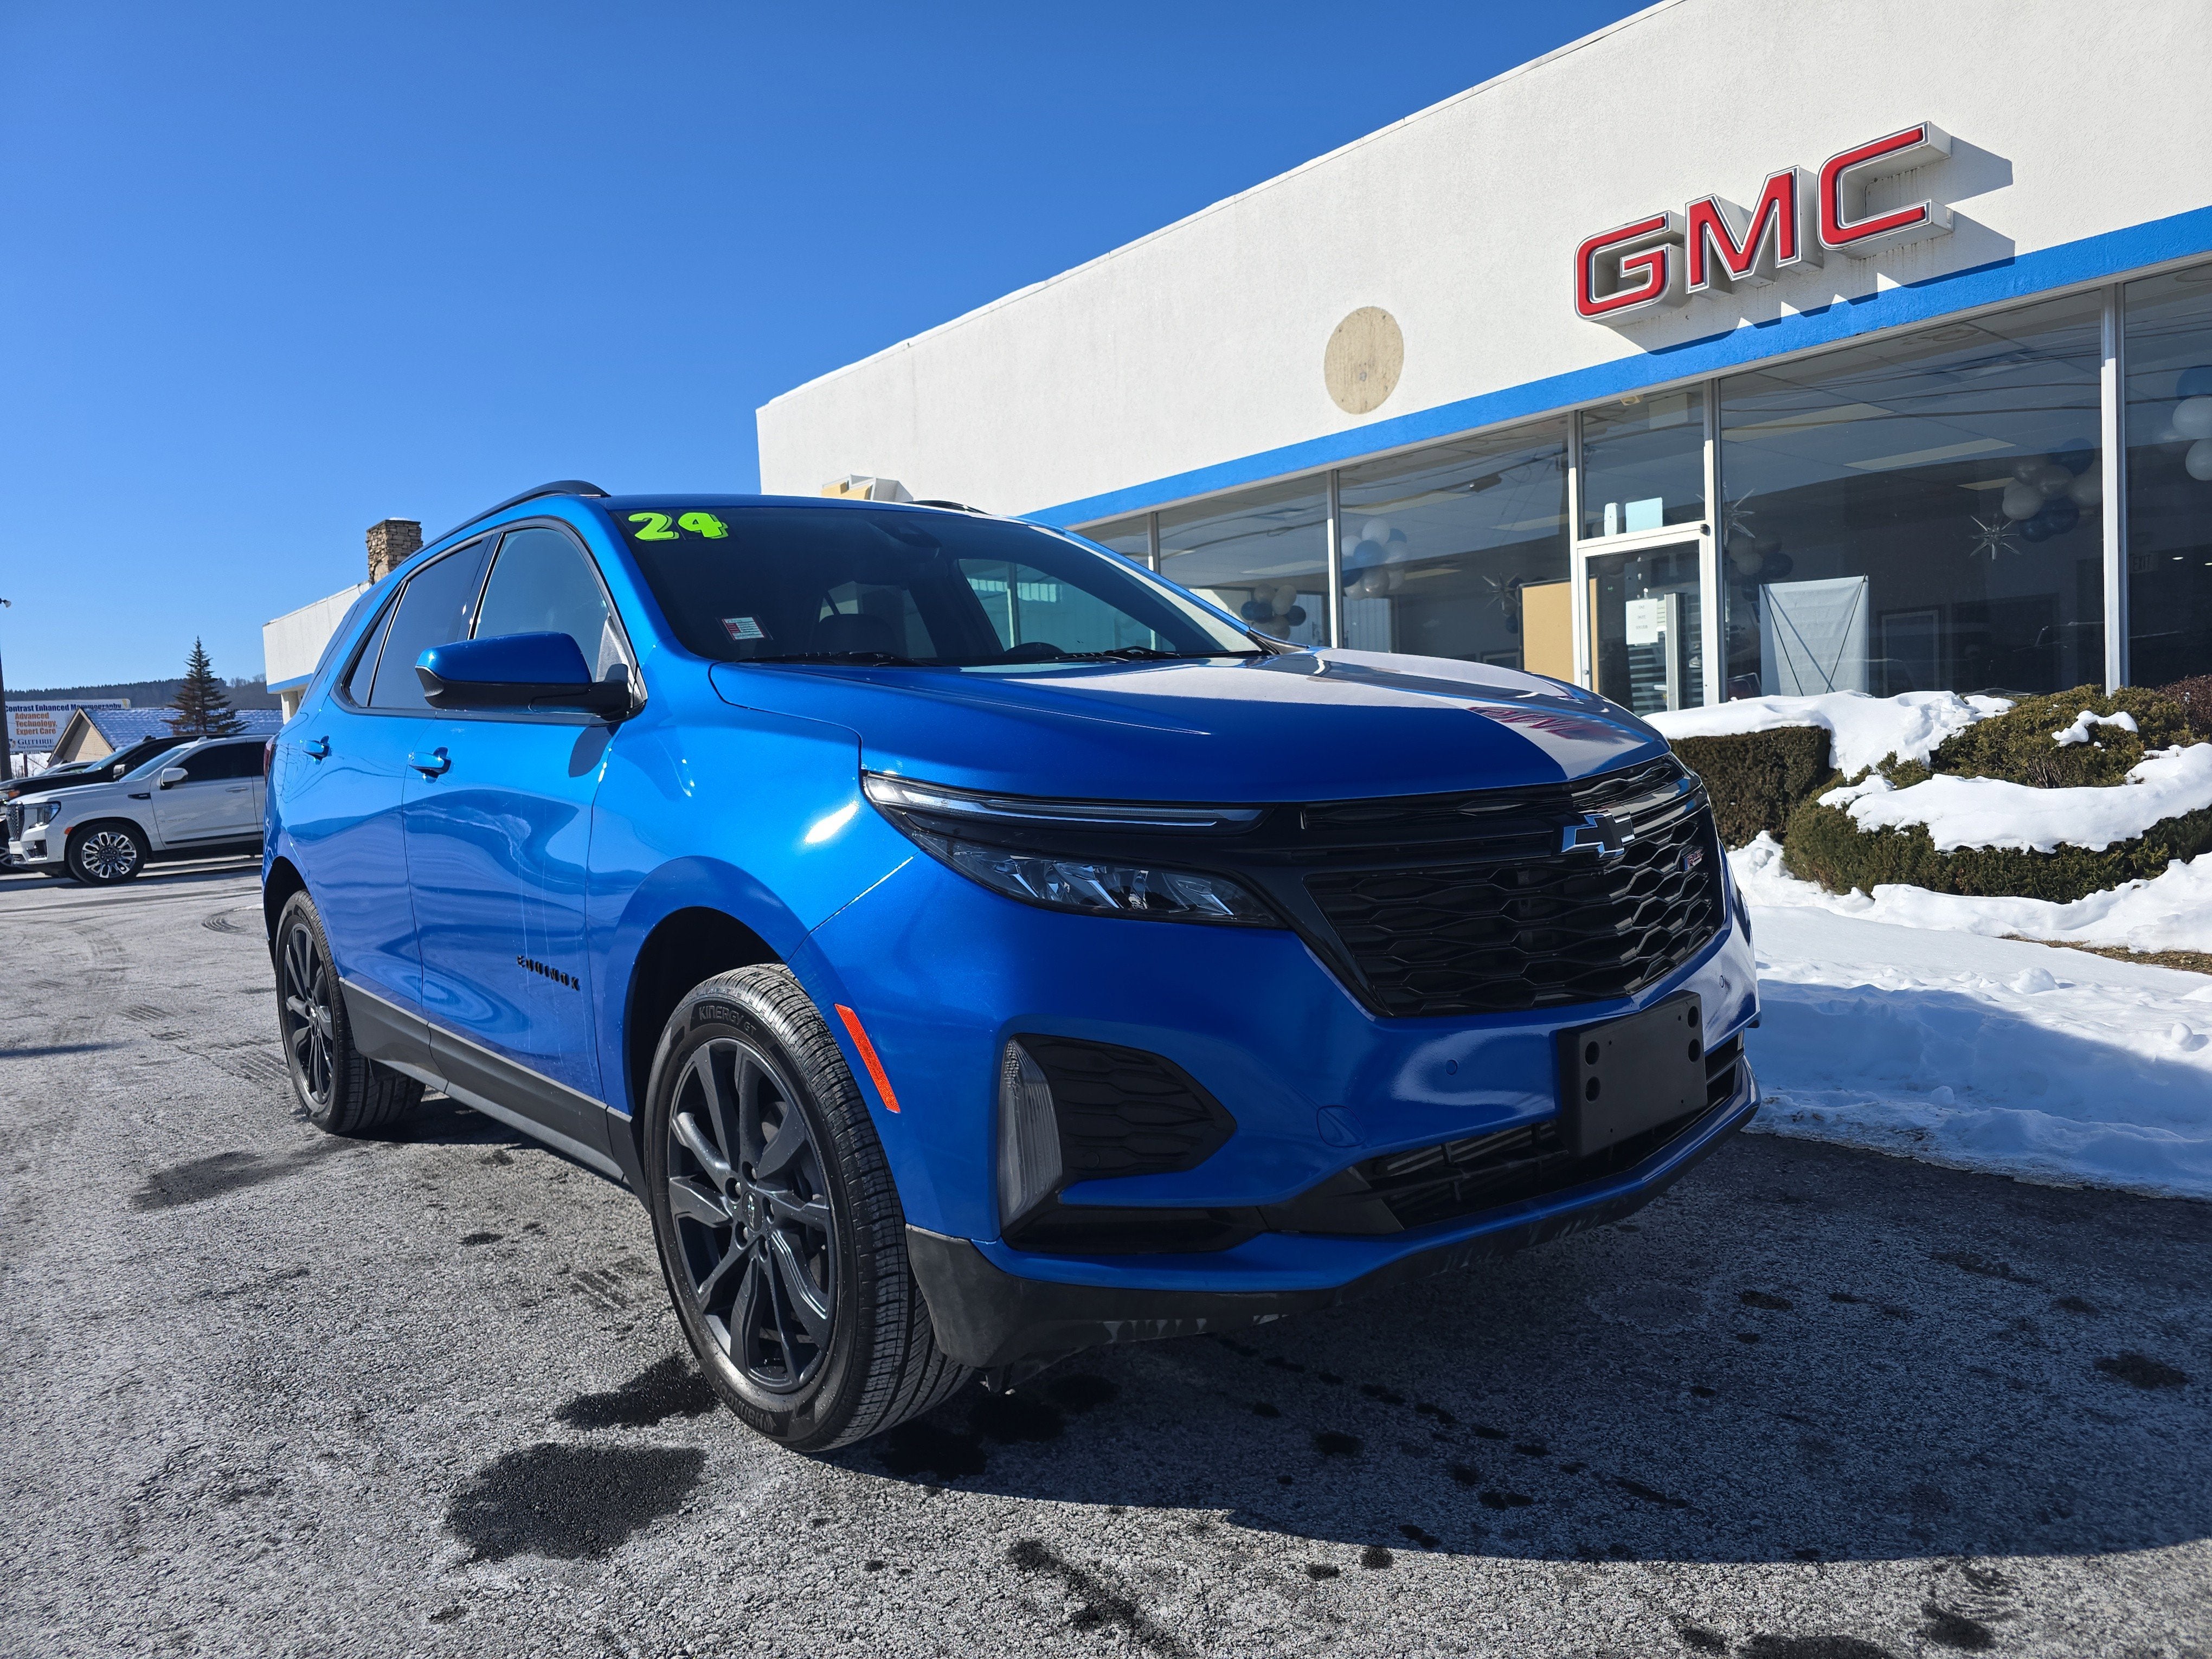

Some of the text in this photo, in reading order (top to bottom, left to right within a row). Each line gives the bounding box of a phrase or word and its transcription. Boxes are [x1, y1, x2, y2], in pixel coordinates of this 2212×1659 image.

[1574, 120, 1952, 323] GMC
[628, 512, 729, 541] 24
[1686, 849, 1702, 871] RS
[698, 1005, 757, 1036] KINERGY GT
